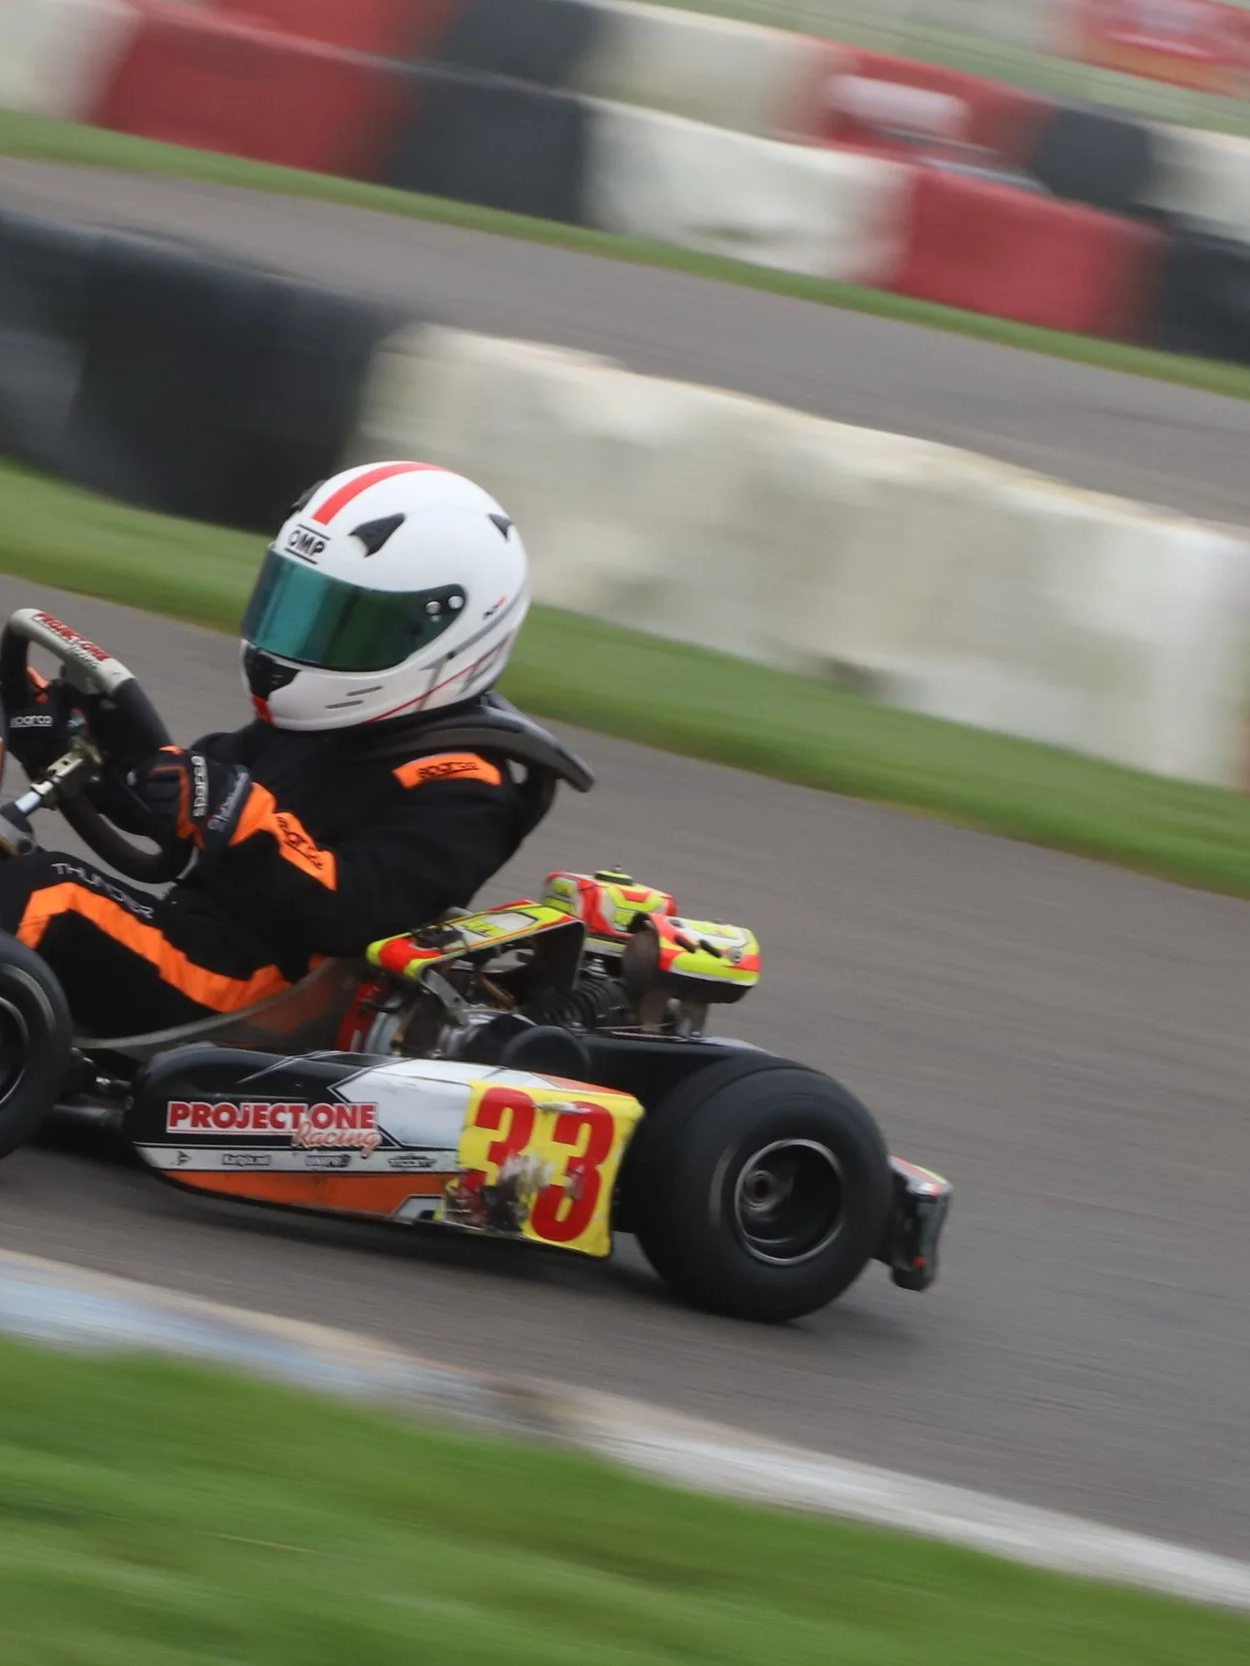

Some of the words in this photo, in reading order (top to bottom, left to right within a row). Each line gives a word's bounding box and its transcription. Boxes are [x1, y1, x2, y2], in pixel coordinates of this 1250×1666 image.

[288, 529, 326, 556] OMP
[170, 1103, 307, 1130] PROJECT
[309, 1104, 376, 1130] ONE
[293, 1122, 381, 1157] Racing
[452, 1087, 615, 1242] 33
